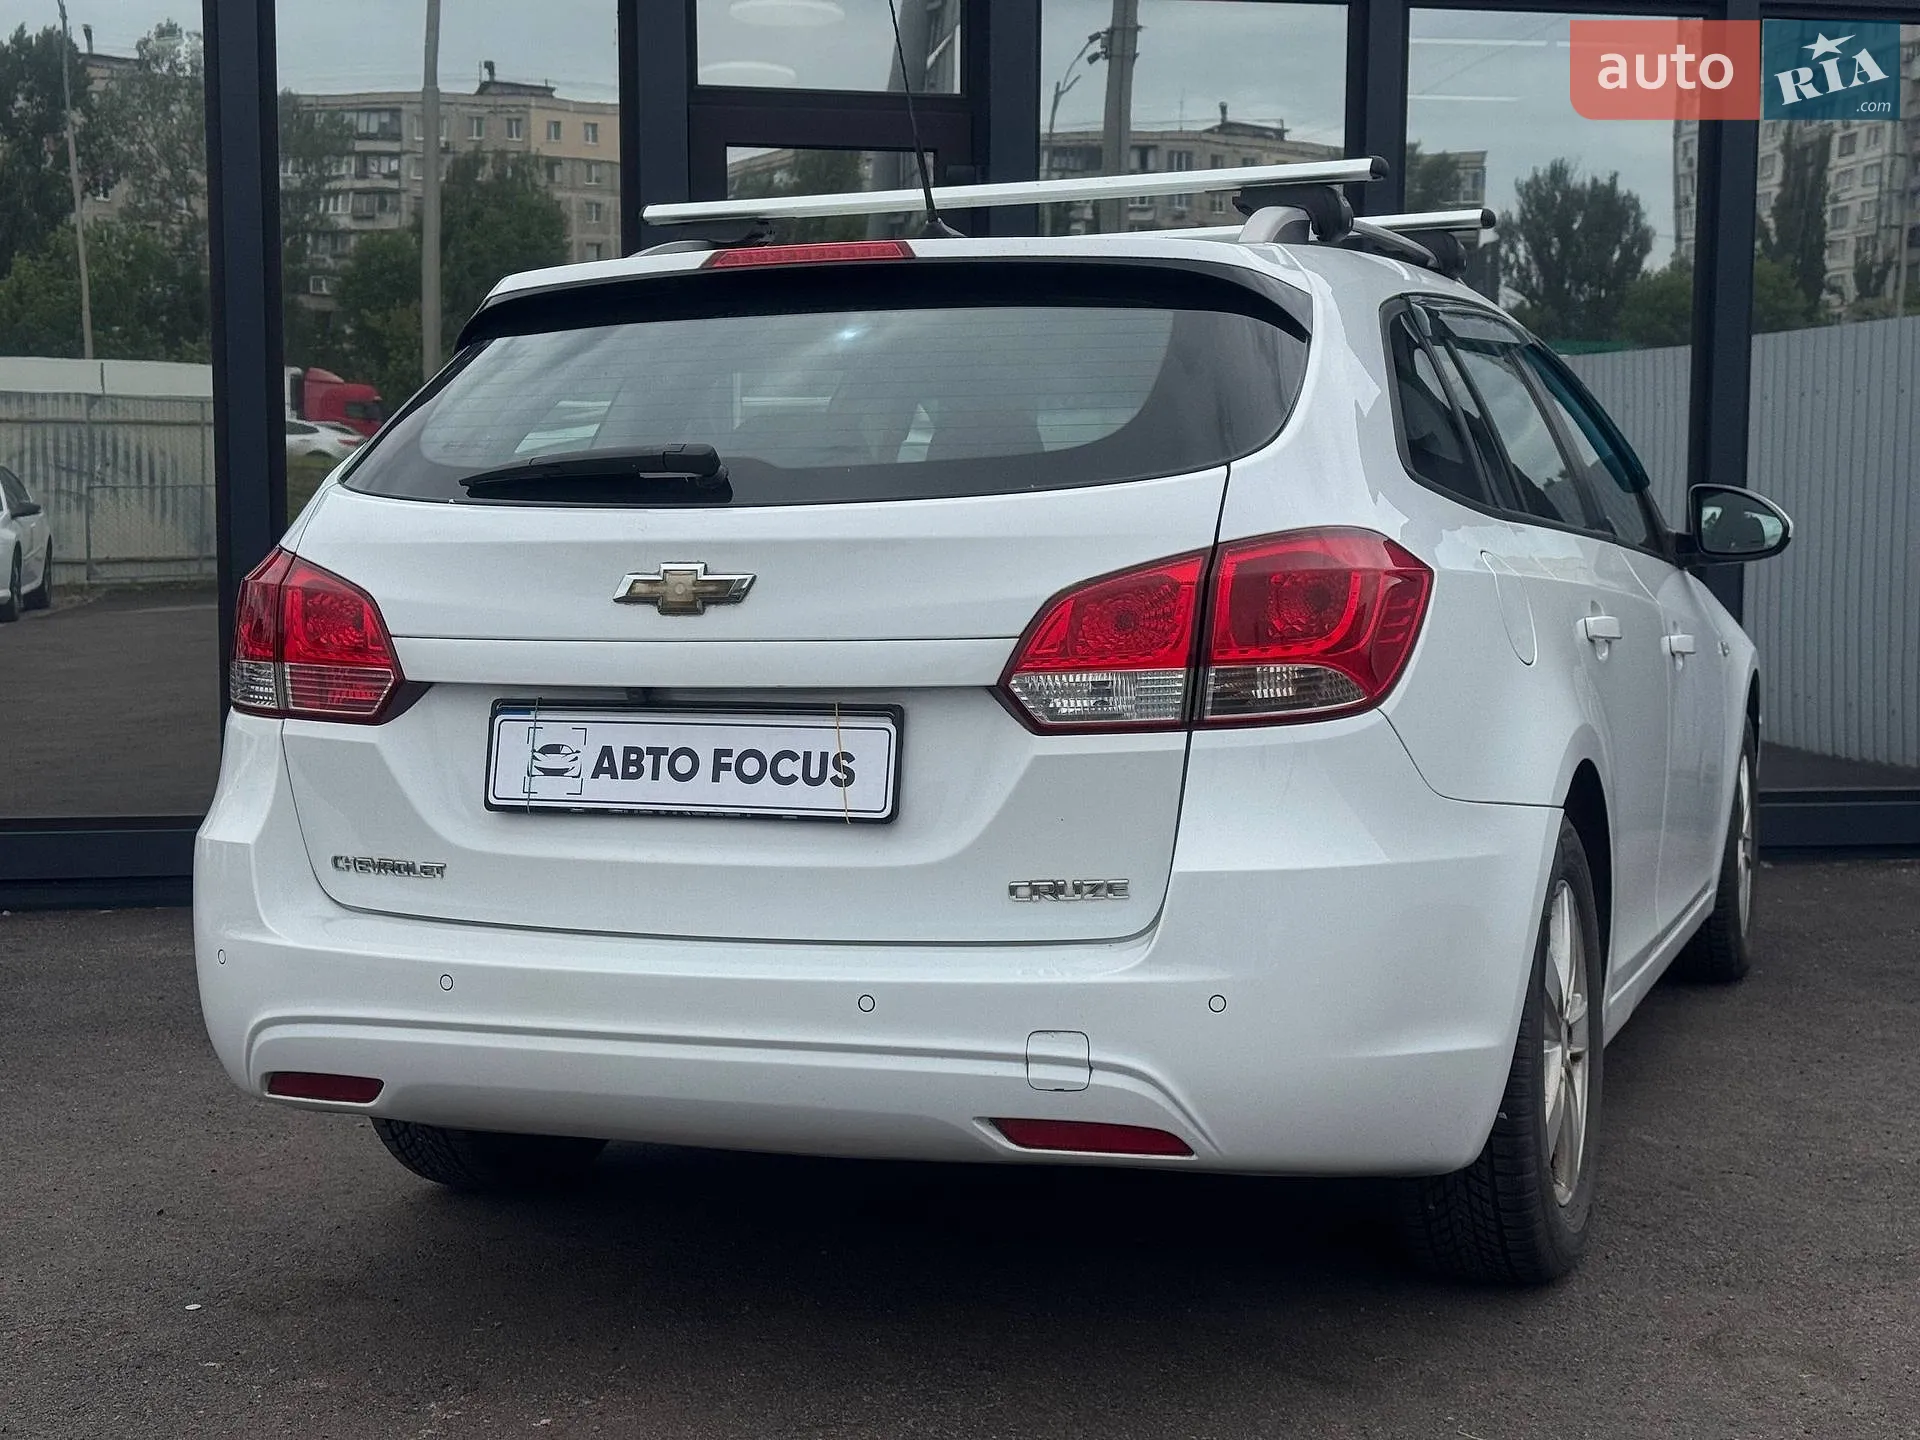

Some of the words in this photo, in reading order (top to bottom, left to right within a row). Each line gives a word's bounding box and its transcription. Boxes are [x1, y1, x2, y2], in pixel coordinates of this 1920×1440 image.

[711, 748, 856, 787] FOCUS
[331, 855, 447, 879] CHEVROLET
[1008, 879, 1130, 902] CRUZE
